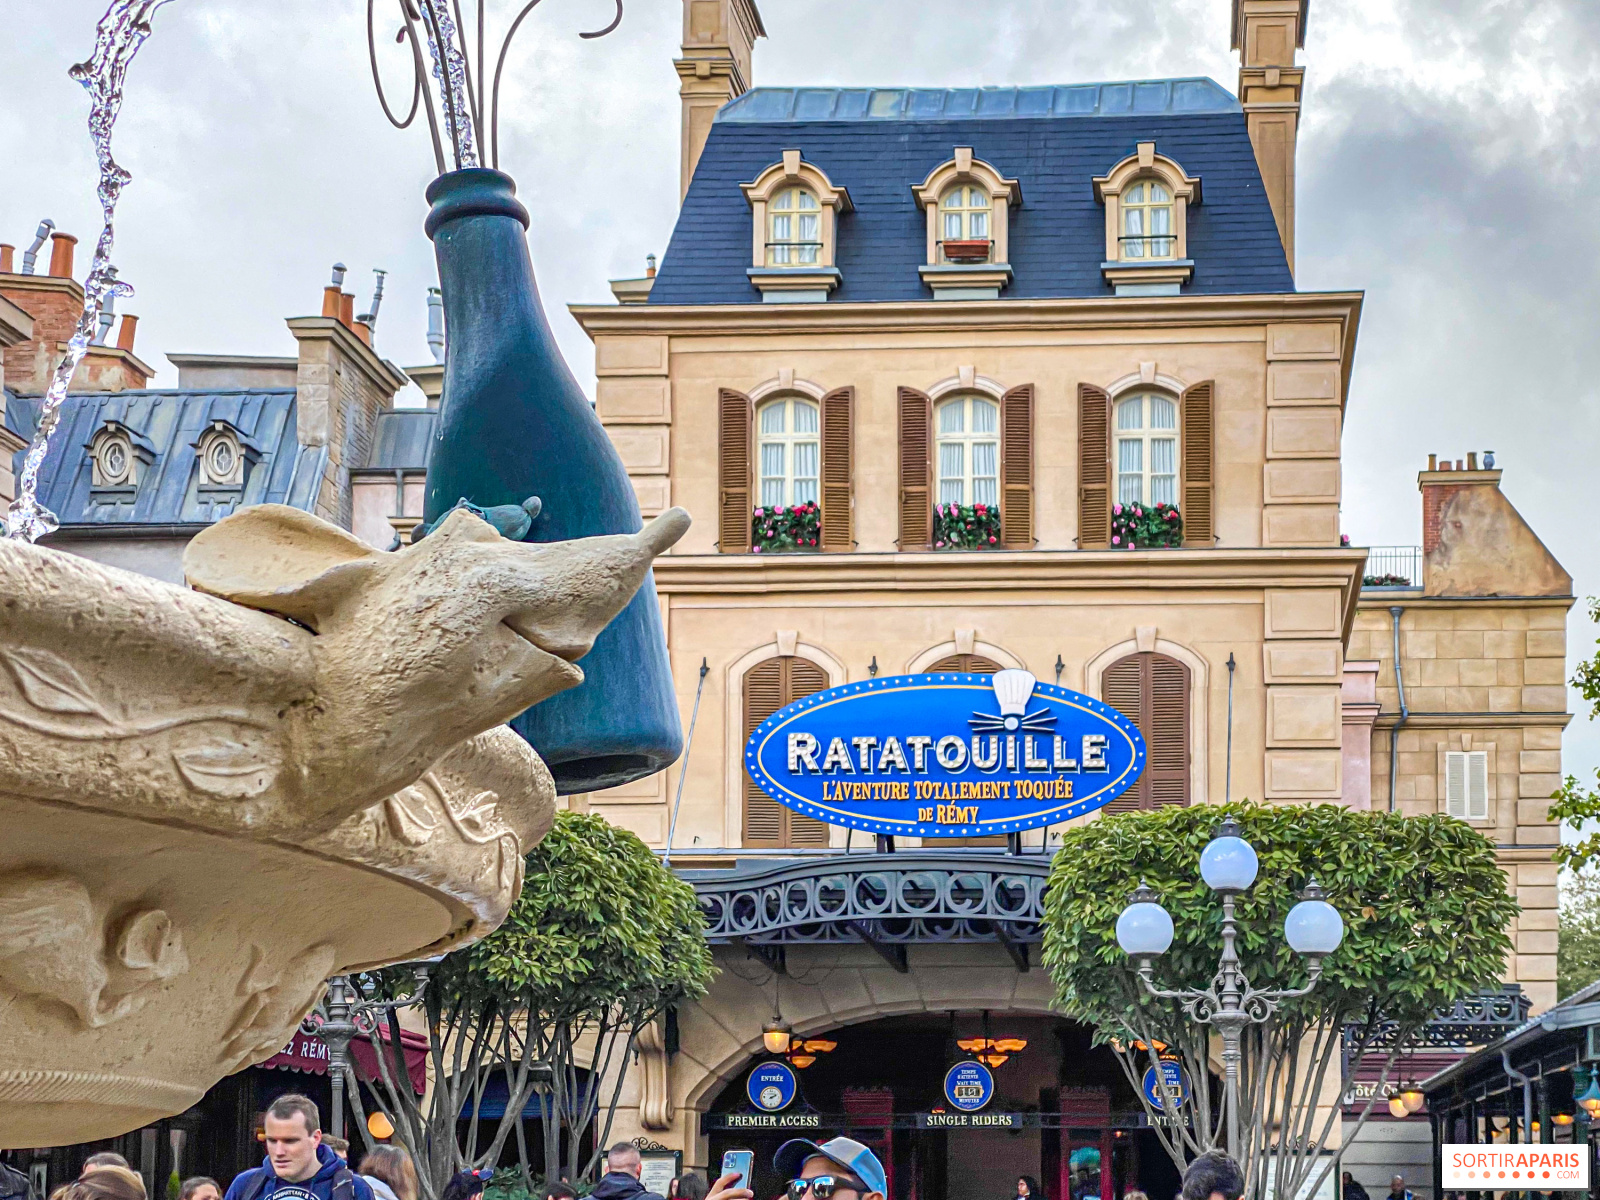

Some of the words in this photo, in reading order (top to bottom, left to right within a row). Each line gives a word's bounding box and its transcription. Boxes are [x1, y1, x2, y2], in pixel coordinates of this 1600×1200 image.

[787, 732, 1109, 774] RATATOUILLE
[822, 780, 910, 801] L'AVENTURE
[914, 780, 1010, 800] TOTALEMENT
[1014, 775, 1073, 800] TOQUÉE
[918, 807, 934, 822] DE
[936, 800, 979, 824] RÉMY
[761, 1074, 784, 1082] ENTRÉE
[728, 1115, 777, 1127] PREMIER
[779, 1115, 819, 1127] ACCESS
[926, 1115, 968, 1126] SINGLE
[971, 1115, 1012, 1126] RIDERS
